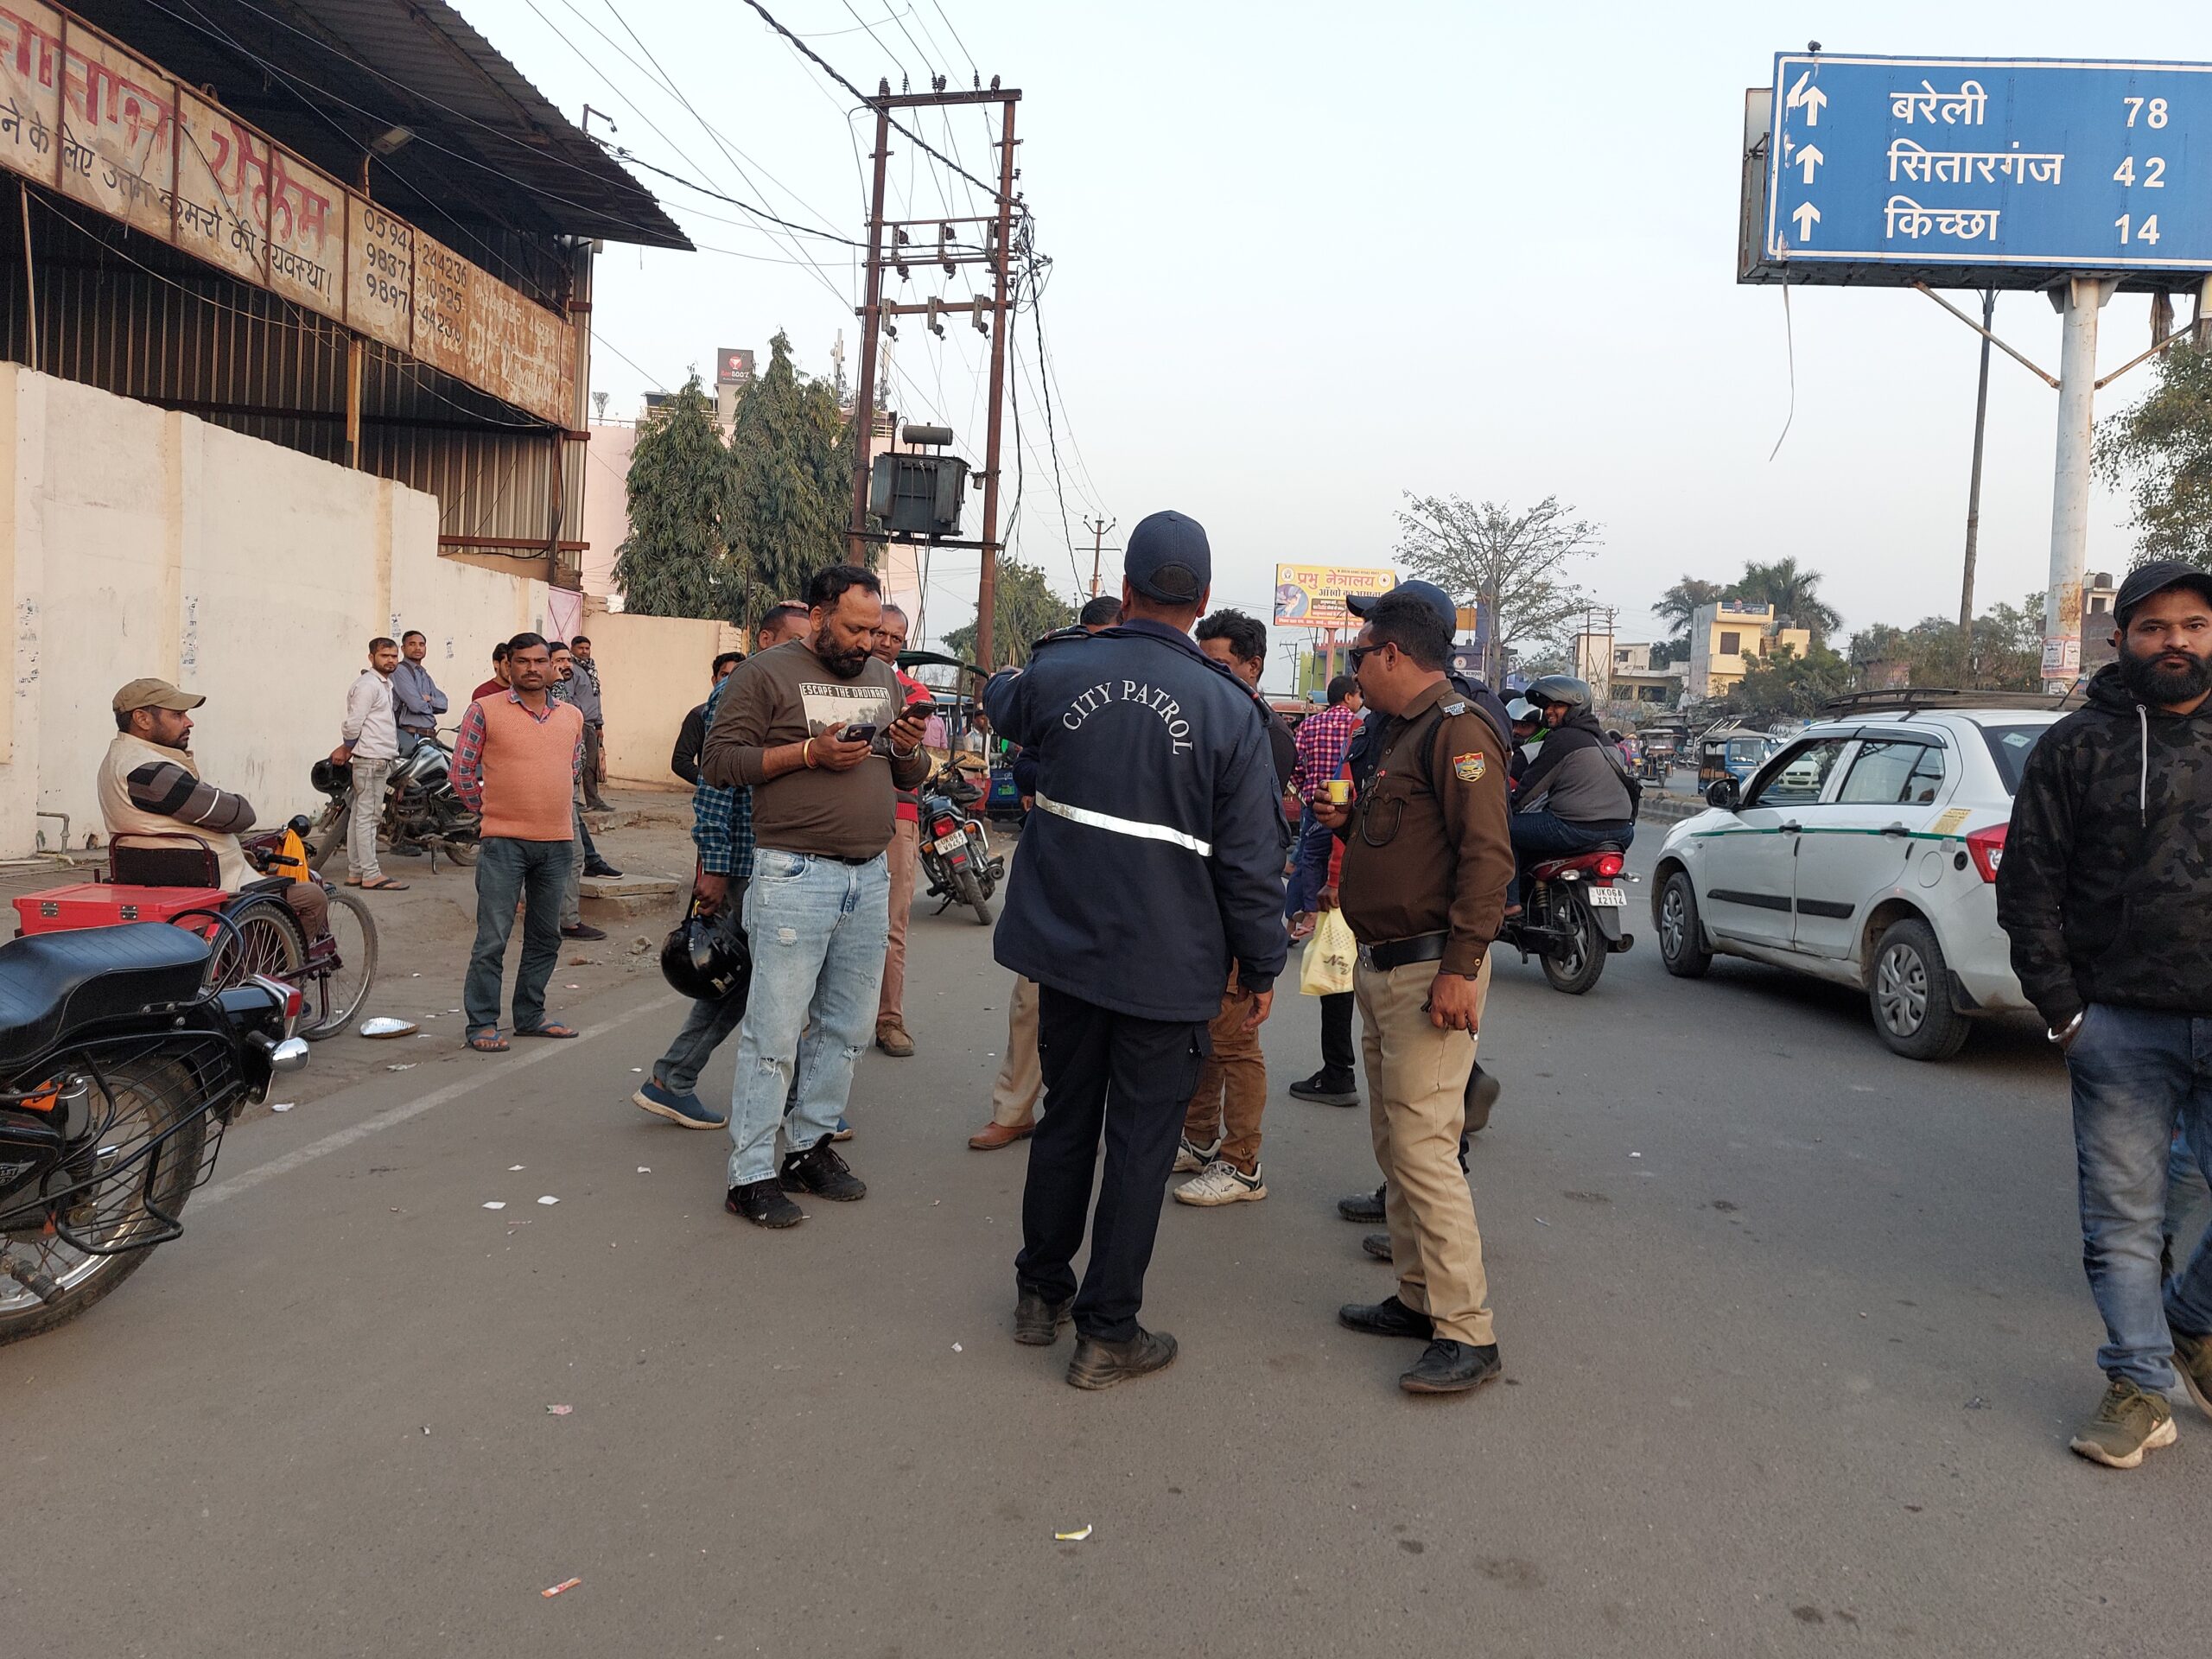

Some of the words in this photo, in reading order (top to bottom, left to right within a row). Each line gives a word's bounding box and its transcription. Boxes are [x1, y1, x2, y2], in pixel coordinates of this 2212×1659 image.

[1890, 79, 1988, 124] बरेली
[2123, 97, 2169, 129] 78
[29, 111, 50, 154] के
[1887, 137, 2065, 185] सितारगंज
[2113, 156, 2166, 188] 42
[1885, 194, 2000, 241] किच्छा
[2114, 213, 2160, 245] 14
[1297, 572, 1319, 588] प्रभु
[1325, 569, 1376, 587] नेत्रालय
[802, 685, 833, 696] ESCAPE
[835, 687, 850, 698] THE
[852, 689, 890, 699] ORDINARY
[1063, 682, 1113, 731] CITY
[1121, 680, 1193, 755] PATROL
[1596, 888, 1623, 897] UK06A
